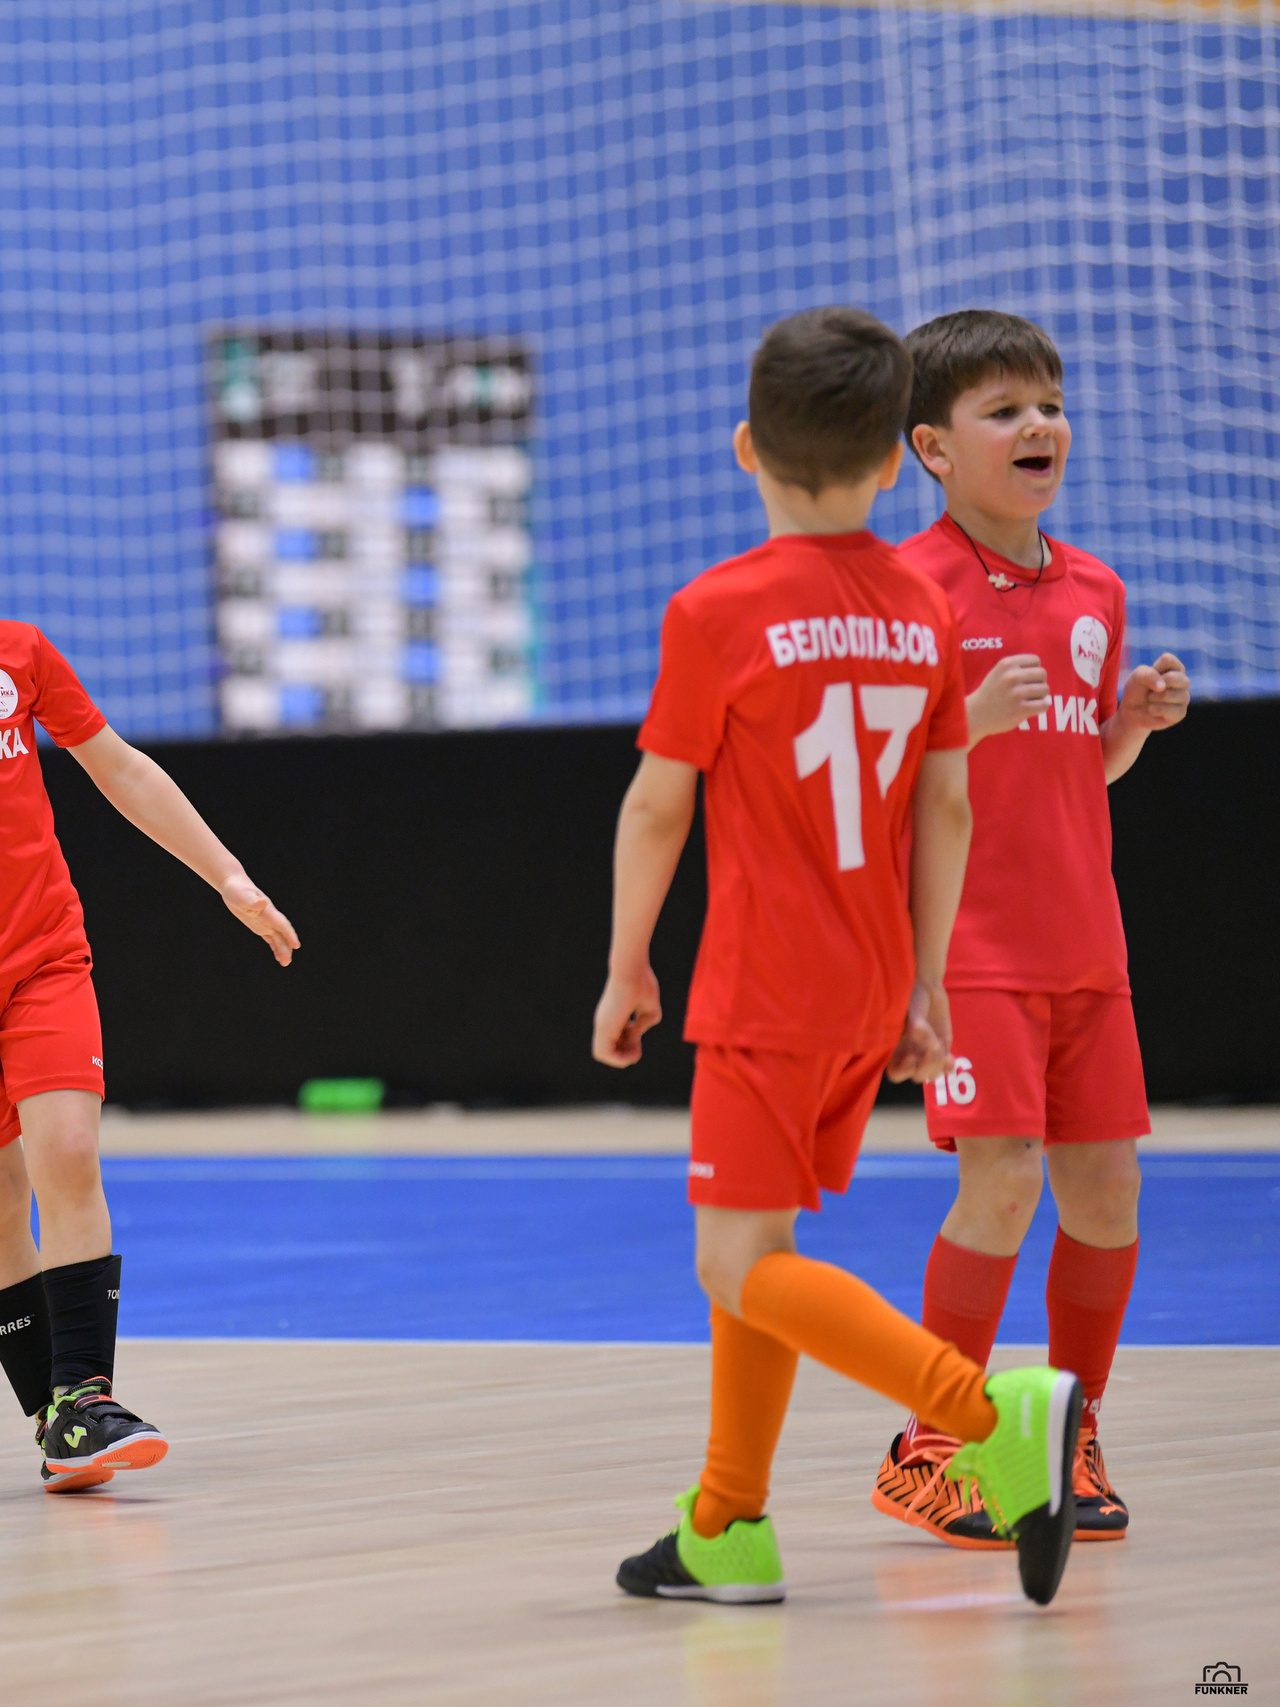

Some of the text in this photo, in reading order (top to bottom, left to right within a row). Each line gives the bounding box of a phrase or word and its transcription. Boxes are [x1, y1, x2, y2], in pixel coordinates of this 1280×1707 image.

[766, 614, 939, 668] БЕЛОГЛАЗОВ
[793, 681, 929, 872] 17
[926, 1056, 976, 1106] 16
